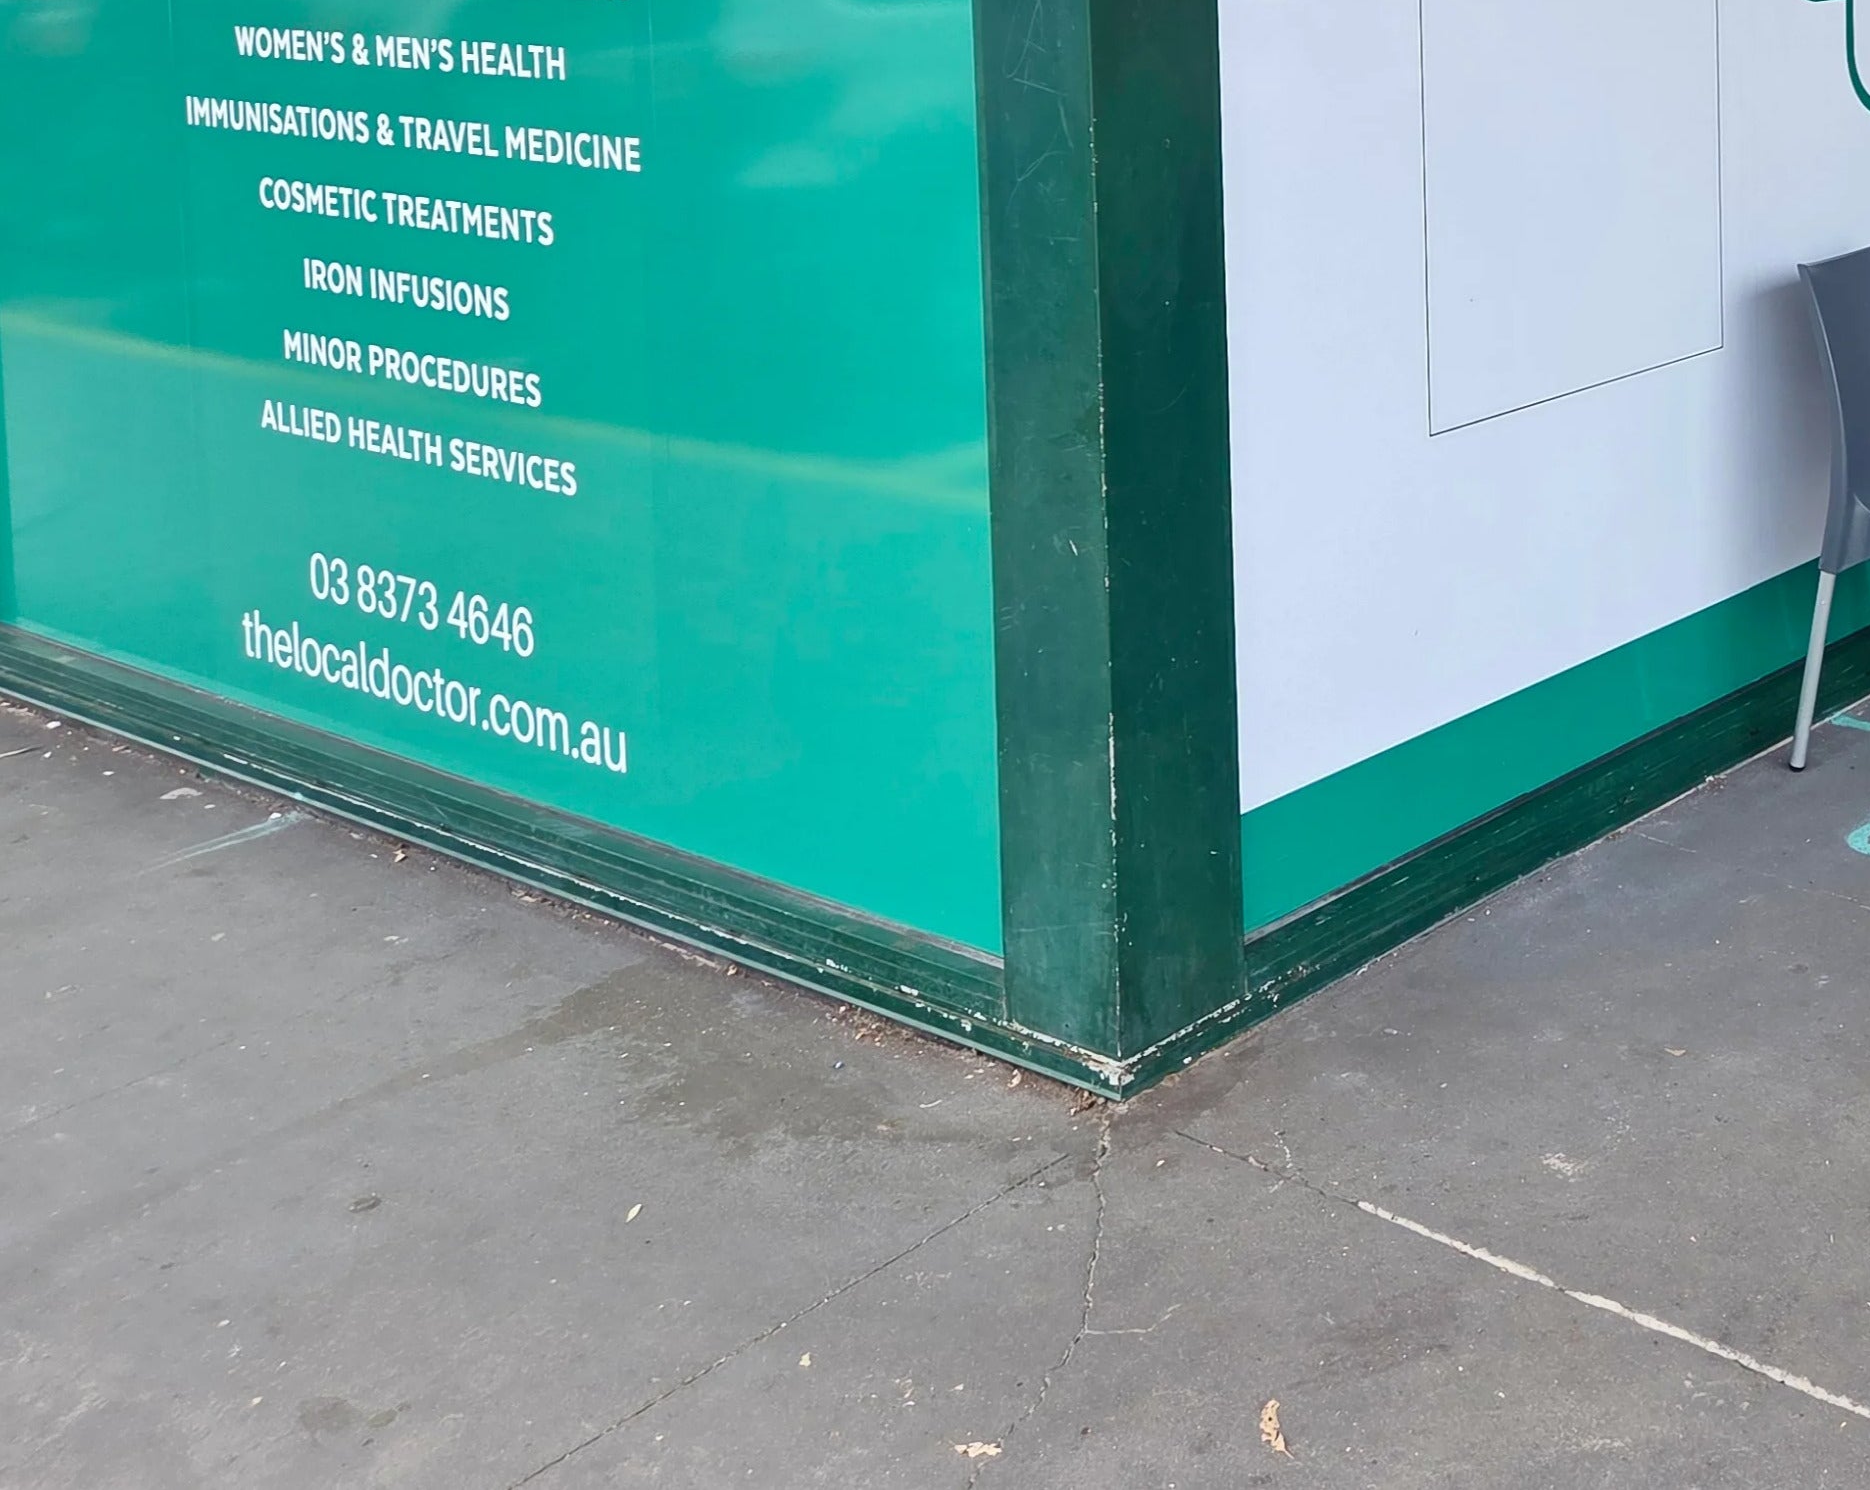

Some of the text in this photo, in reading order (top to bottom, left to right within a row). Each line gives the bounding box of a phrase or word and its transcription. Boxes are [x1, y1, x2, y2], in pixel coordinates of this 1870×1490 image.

[234, 25, 566, 80] WOMEN'S & MEN'S HEALTH
[186, 95, 641, 172] IMMUNISATIONS & TRAVEL MEDICINE
[259, 177, 554, 246] COSMETIC TREATMENTS
[303, 257, 510, 321] IRON INFUSIONS
[283, 329, 542, 407] MINOR PROCEDURES
[260, 399, 577, 496] ALLIED HEALTH SERVICES
[310, 552, 534, 657] 03 8373 4646
[242, 609, 627, 773] thelocaldoctor.com.au
